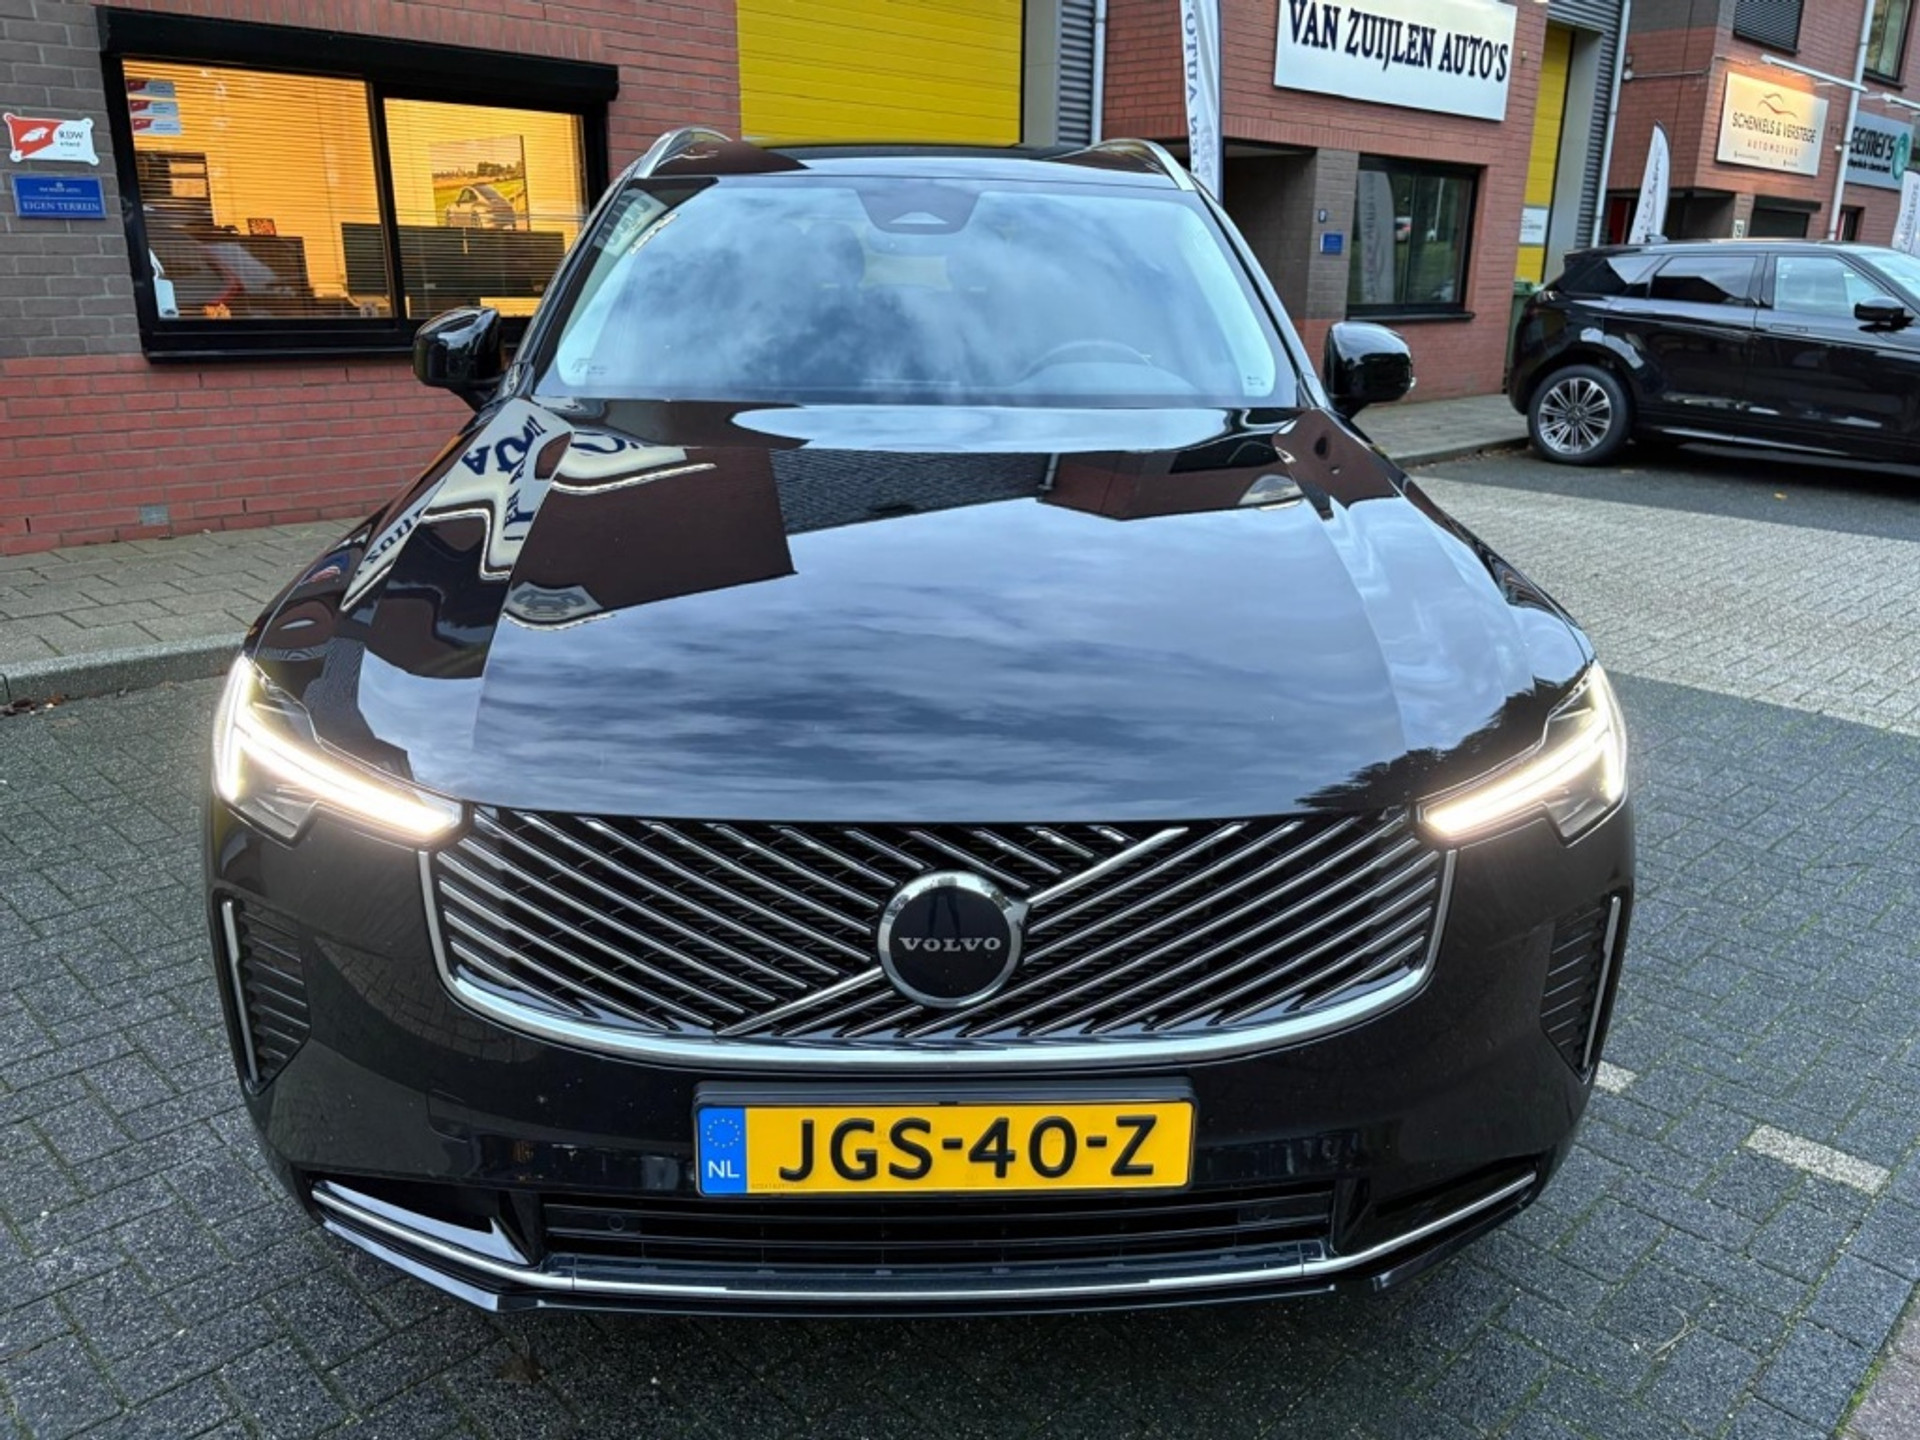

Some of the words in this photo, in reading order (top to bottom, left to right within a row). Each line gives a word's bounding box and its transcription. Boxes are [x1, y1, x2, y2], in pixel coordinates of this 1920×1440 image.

[1288, 0, 1341, 51] VAN
[1345, 8, 1437, 72] ZUIJLEN
[1438, 32, 1509, 83] AUTO'S
[899, 936, 1001, 953] VOLVO
[708, 1160, 740, 1178] NL
[778, 1114, 1158, 1182] JGS-40-Z
